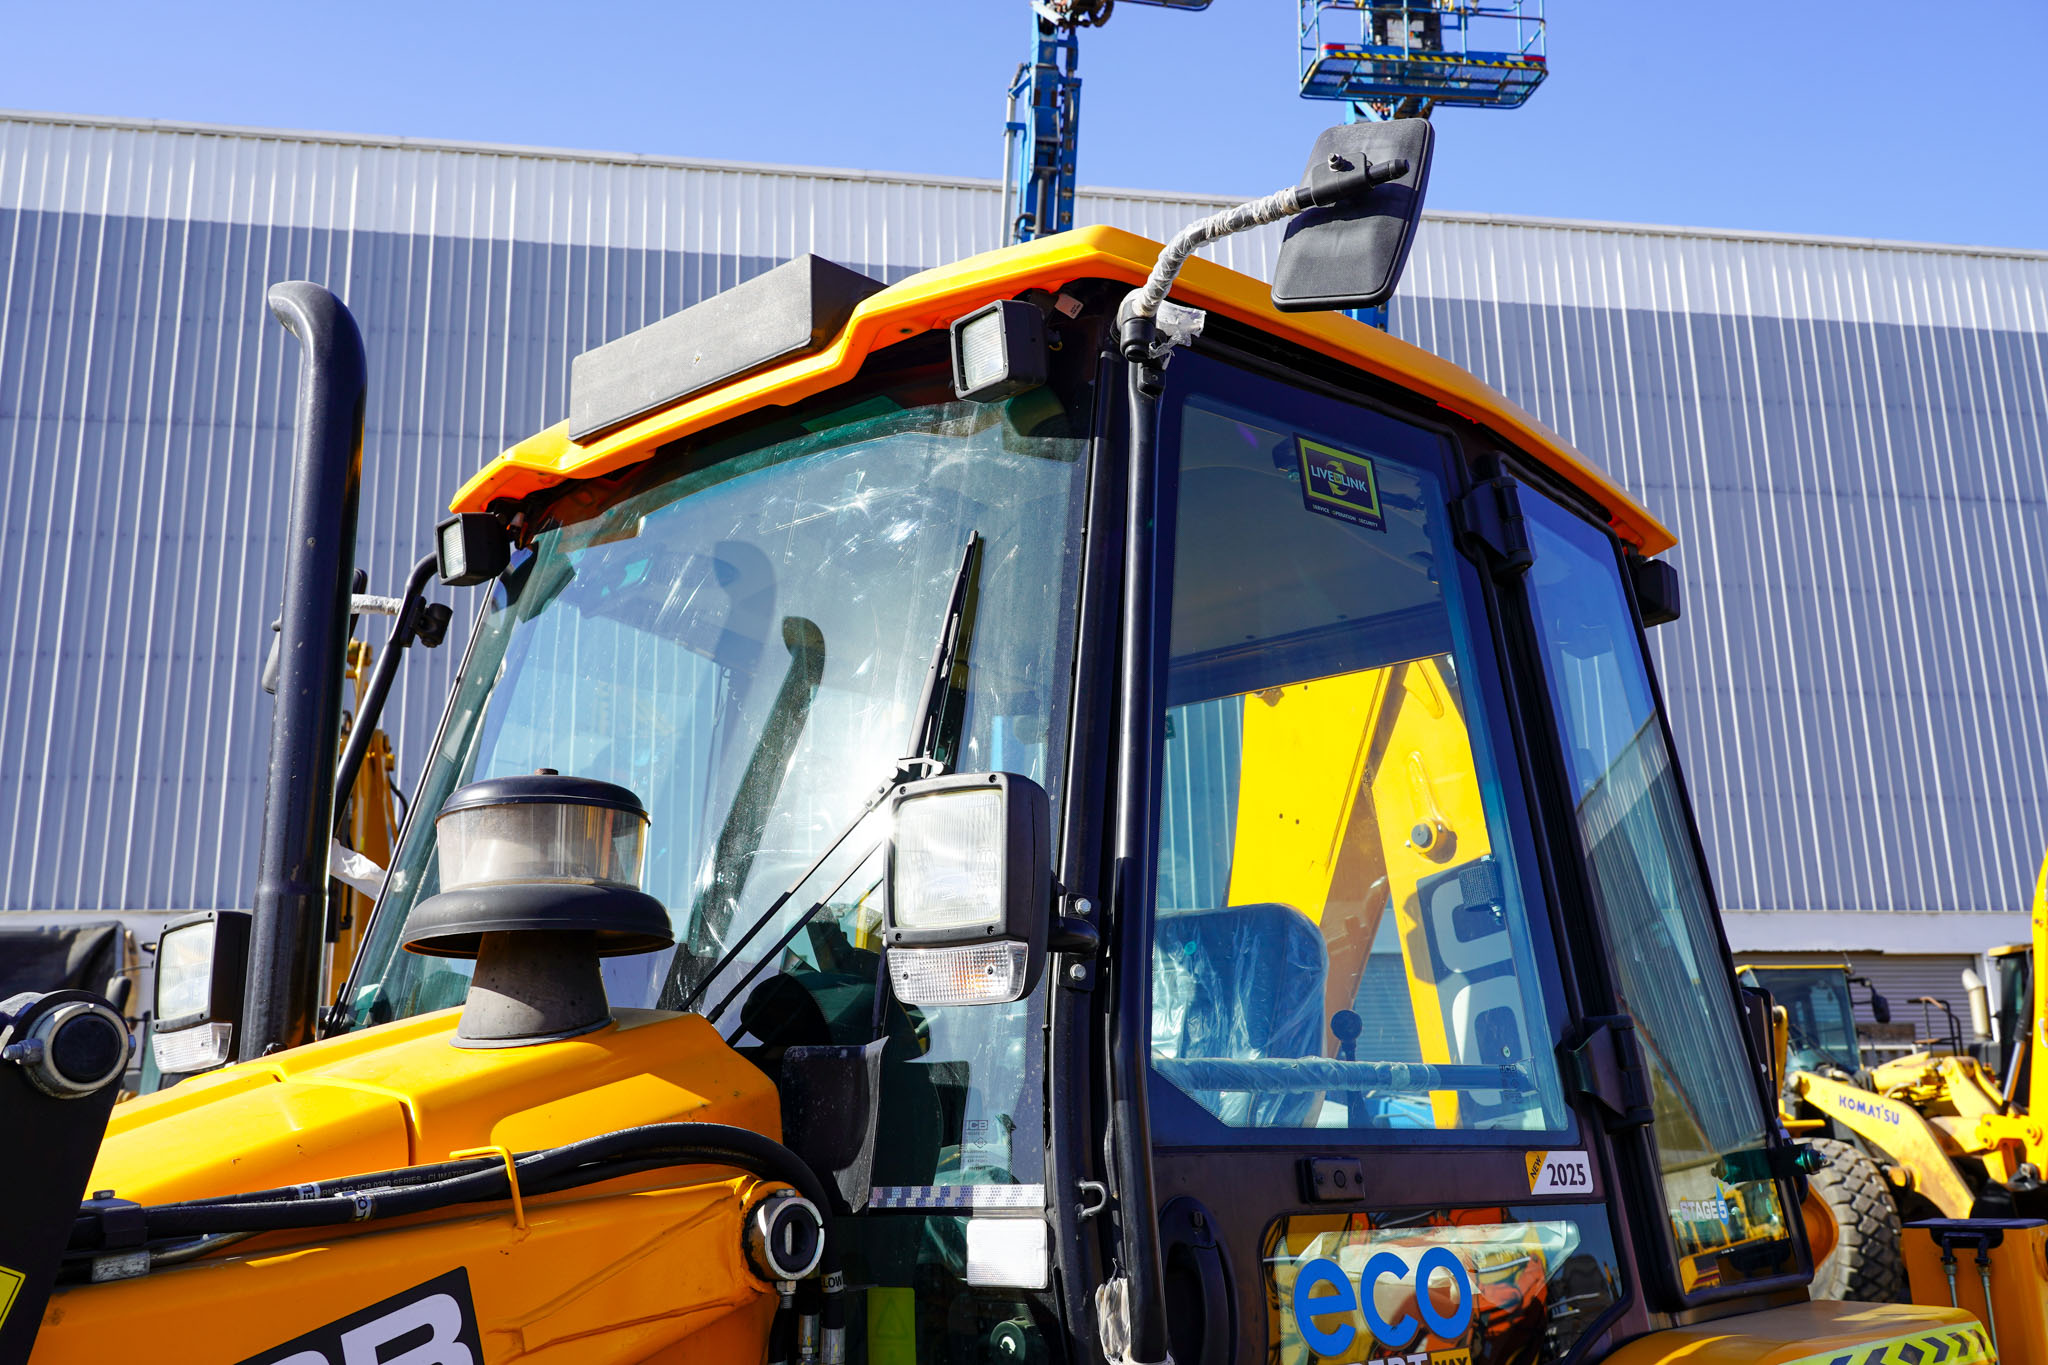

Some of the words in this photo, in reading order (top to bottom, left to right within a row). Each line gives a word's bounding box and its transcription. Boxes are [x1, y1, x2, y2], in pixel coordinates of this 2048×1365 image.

[1838, 1095, 1900, 1125] KOMATSU
[1529, 1155, 1542, 1180] NEW
[1546, 1163, 1587, 1186] 2025
[1293, 1246, 1474, 1357] eco
